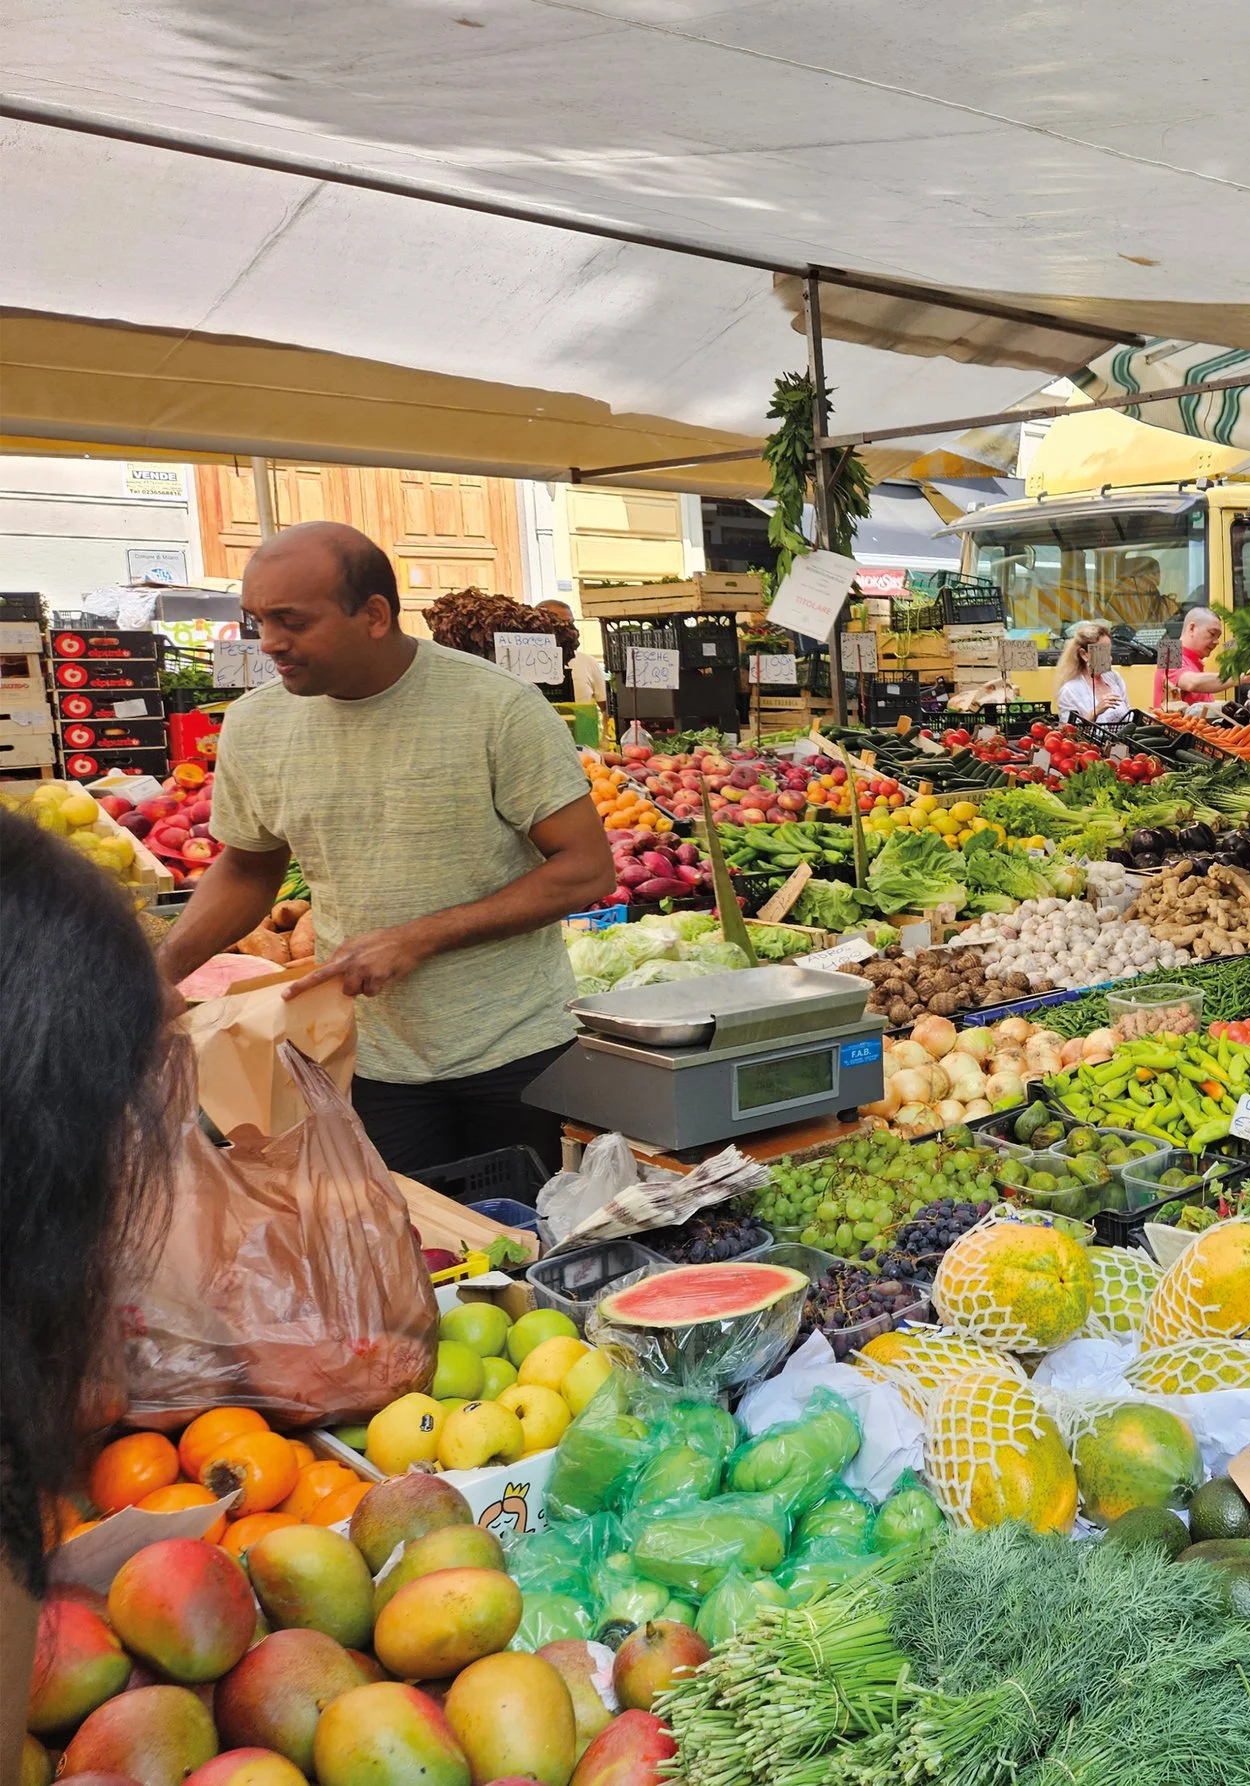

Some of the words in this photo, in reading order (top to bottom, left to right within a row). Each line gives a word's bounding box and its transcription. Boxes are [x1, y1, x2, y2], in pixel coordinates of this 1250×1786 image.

[133, 470, 177, 481] VENDE
[796, 595, 833, 616] TITOLARE
[851, 1047, 872, 1059] F.A.B.
